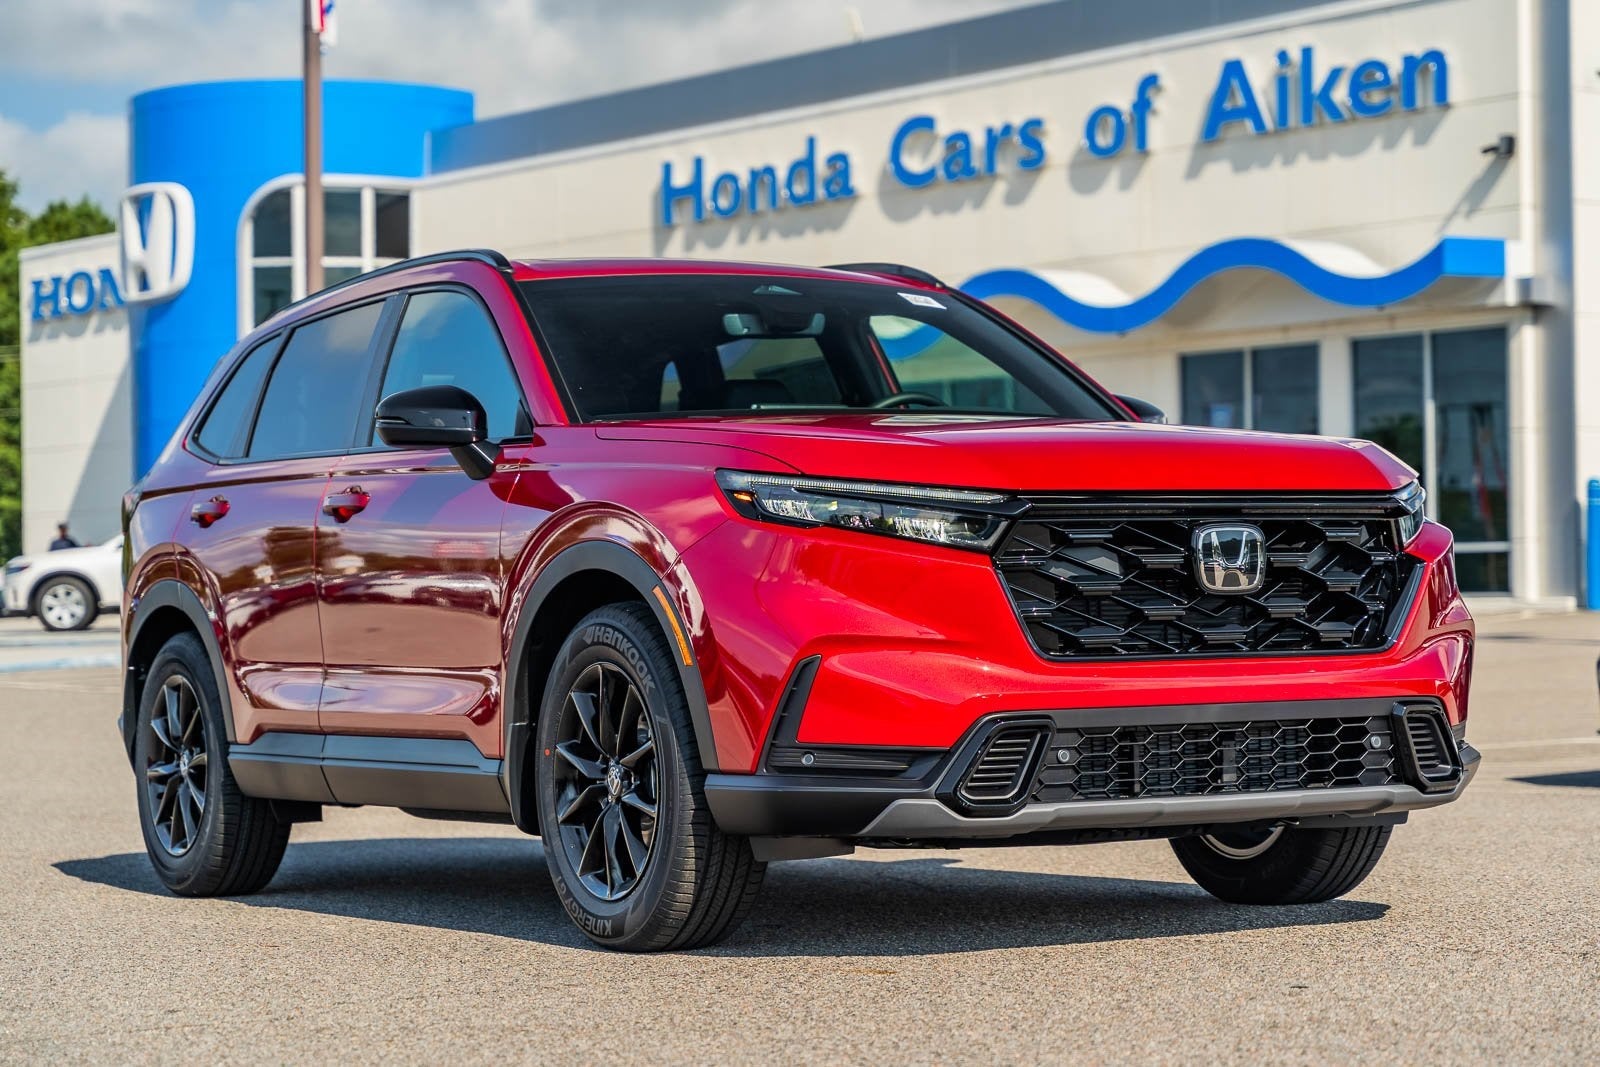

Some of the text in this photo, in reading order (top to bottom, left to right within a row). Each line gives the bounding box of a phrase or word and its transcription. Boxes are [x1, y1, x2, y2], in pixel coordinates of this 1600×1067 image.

[661, 45, 1449, 228] Honda Cars of Aiken
